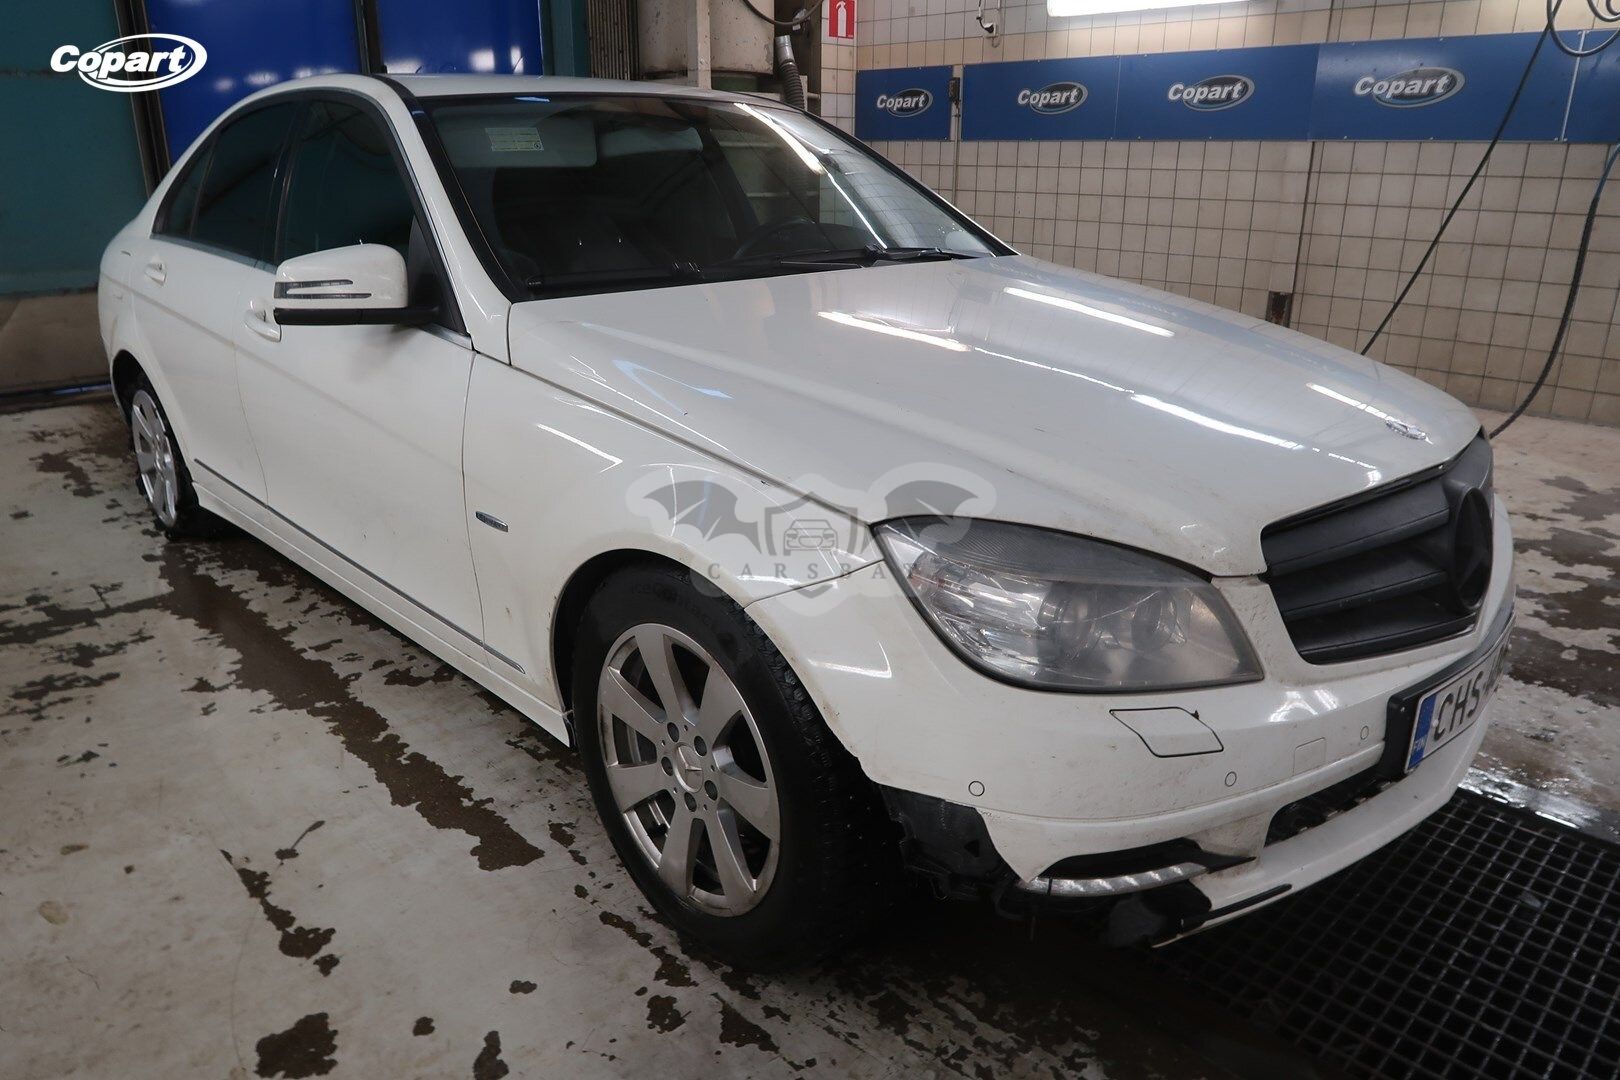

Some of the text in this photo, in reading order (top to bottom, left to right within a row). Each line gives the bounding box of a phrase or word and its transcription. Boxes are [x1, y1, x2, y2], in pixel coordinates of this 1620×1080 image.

[1168, 82, 1242, 103] Copart
[1354, 74, 1450, 99] Copart
[877, 93, 925, 111] Copart
[1018, 88, 1078, 106] Copart
